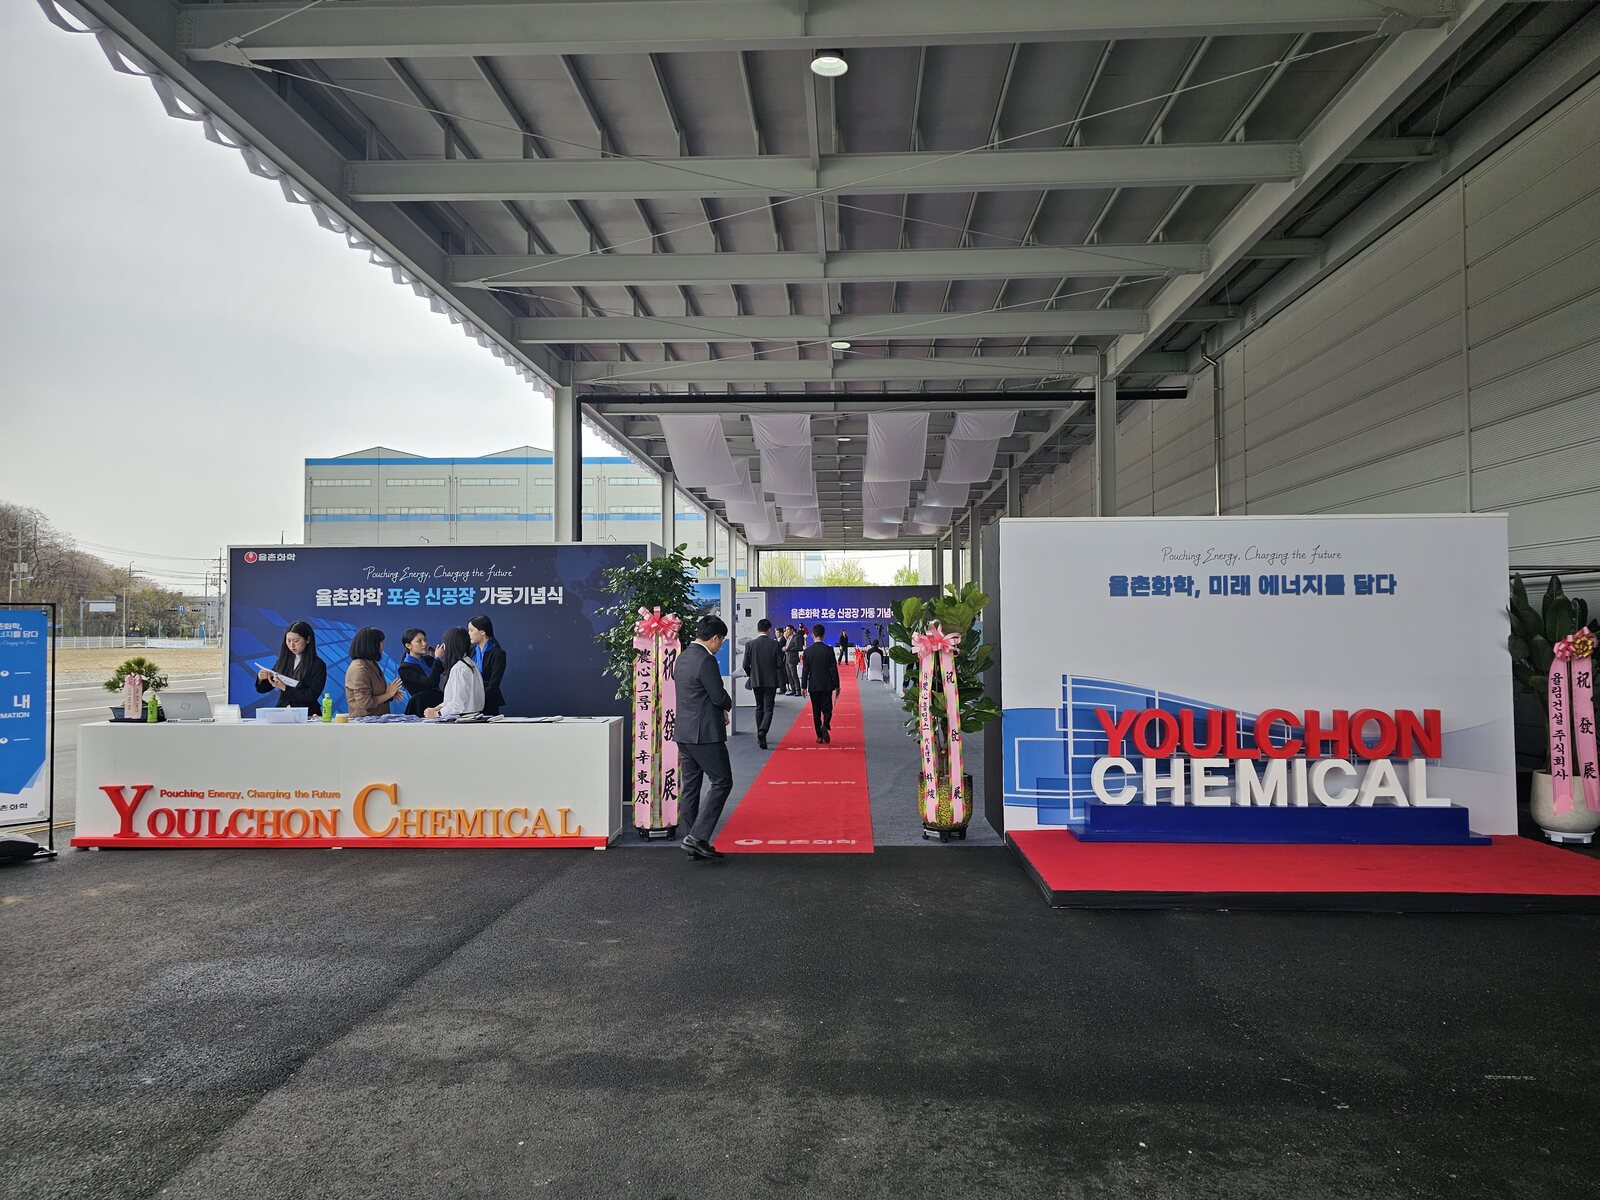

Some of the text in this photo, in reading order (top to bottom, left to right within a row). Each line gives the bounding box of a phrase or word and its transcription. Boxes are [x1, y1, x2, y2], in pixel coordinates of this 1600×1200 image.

[258, 553, 296, 562] 율촌화학
[1161, 547, 1201, 566] Pouching
[1245, 545, 1289, 565] Charging
[1292, 549, 1307, 559] the
[1310, 545, 1342, 564] Future
[434, 564, 470, 583] Charging
[472, 567, 485, 577] the
[315, 586, 563, 606] 율촌화학 포승 신공장 가동기념식
[1109, 574, 1397, 598] 율촌화학, 미래 에너지를 담다
[791, 608, 894, 619] 율촌화학 포승 신공장 가동 기념
[13, 695, 30, 709] 내
[1094, 708, 1442, 759] YOULCHON
[1551, 672, 1569, 781] 율림건설 주식회사
[1091, 757, 1451, 807] CHEMICAL
[160, 789, 341, 799] Pouching Energy, Charging the Future
[99, 783, 581, 838] YOULCHON CHEMICAL
